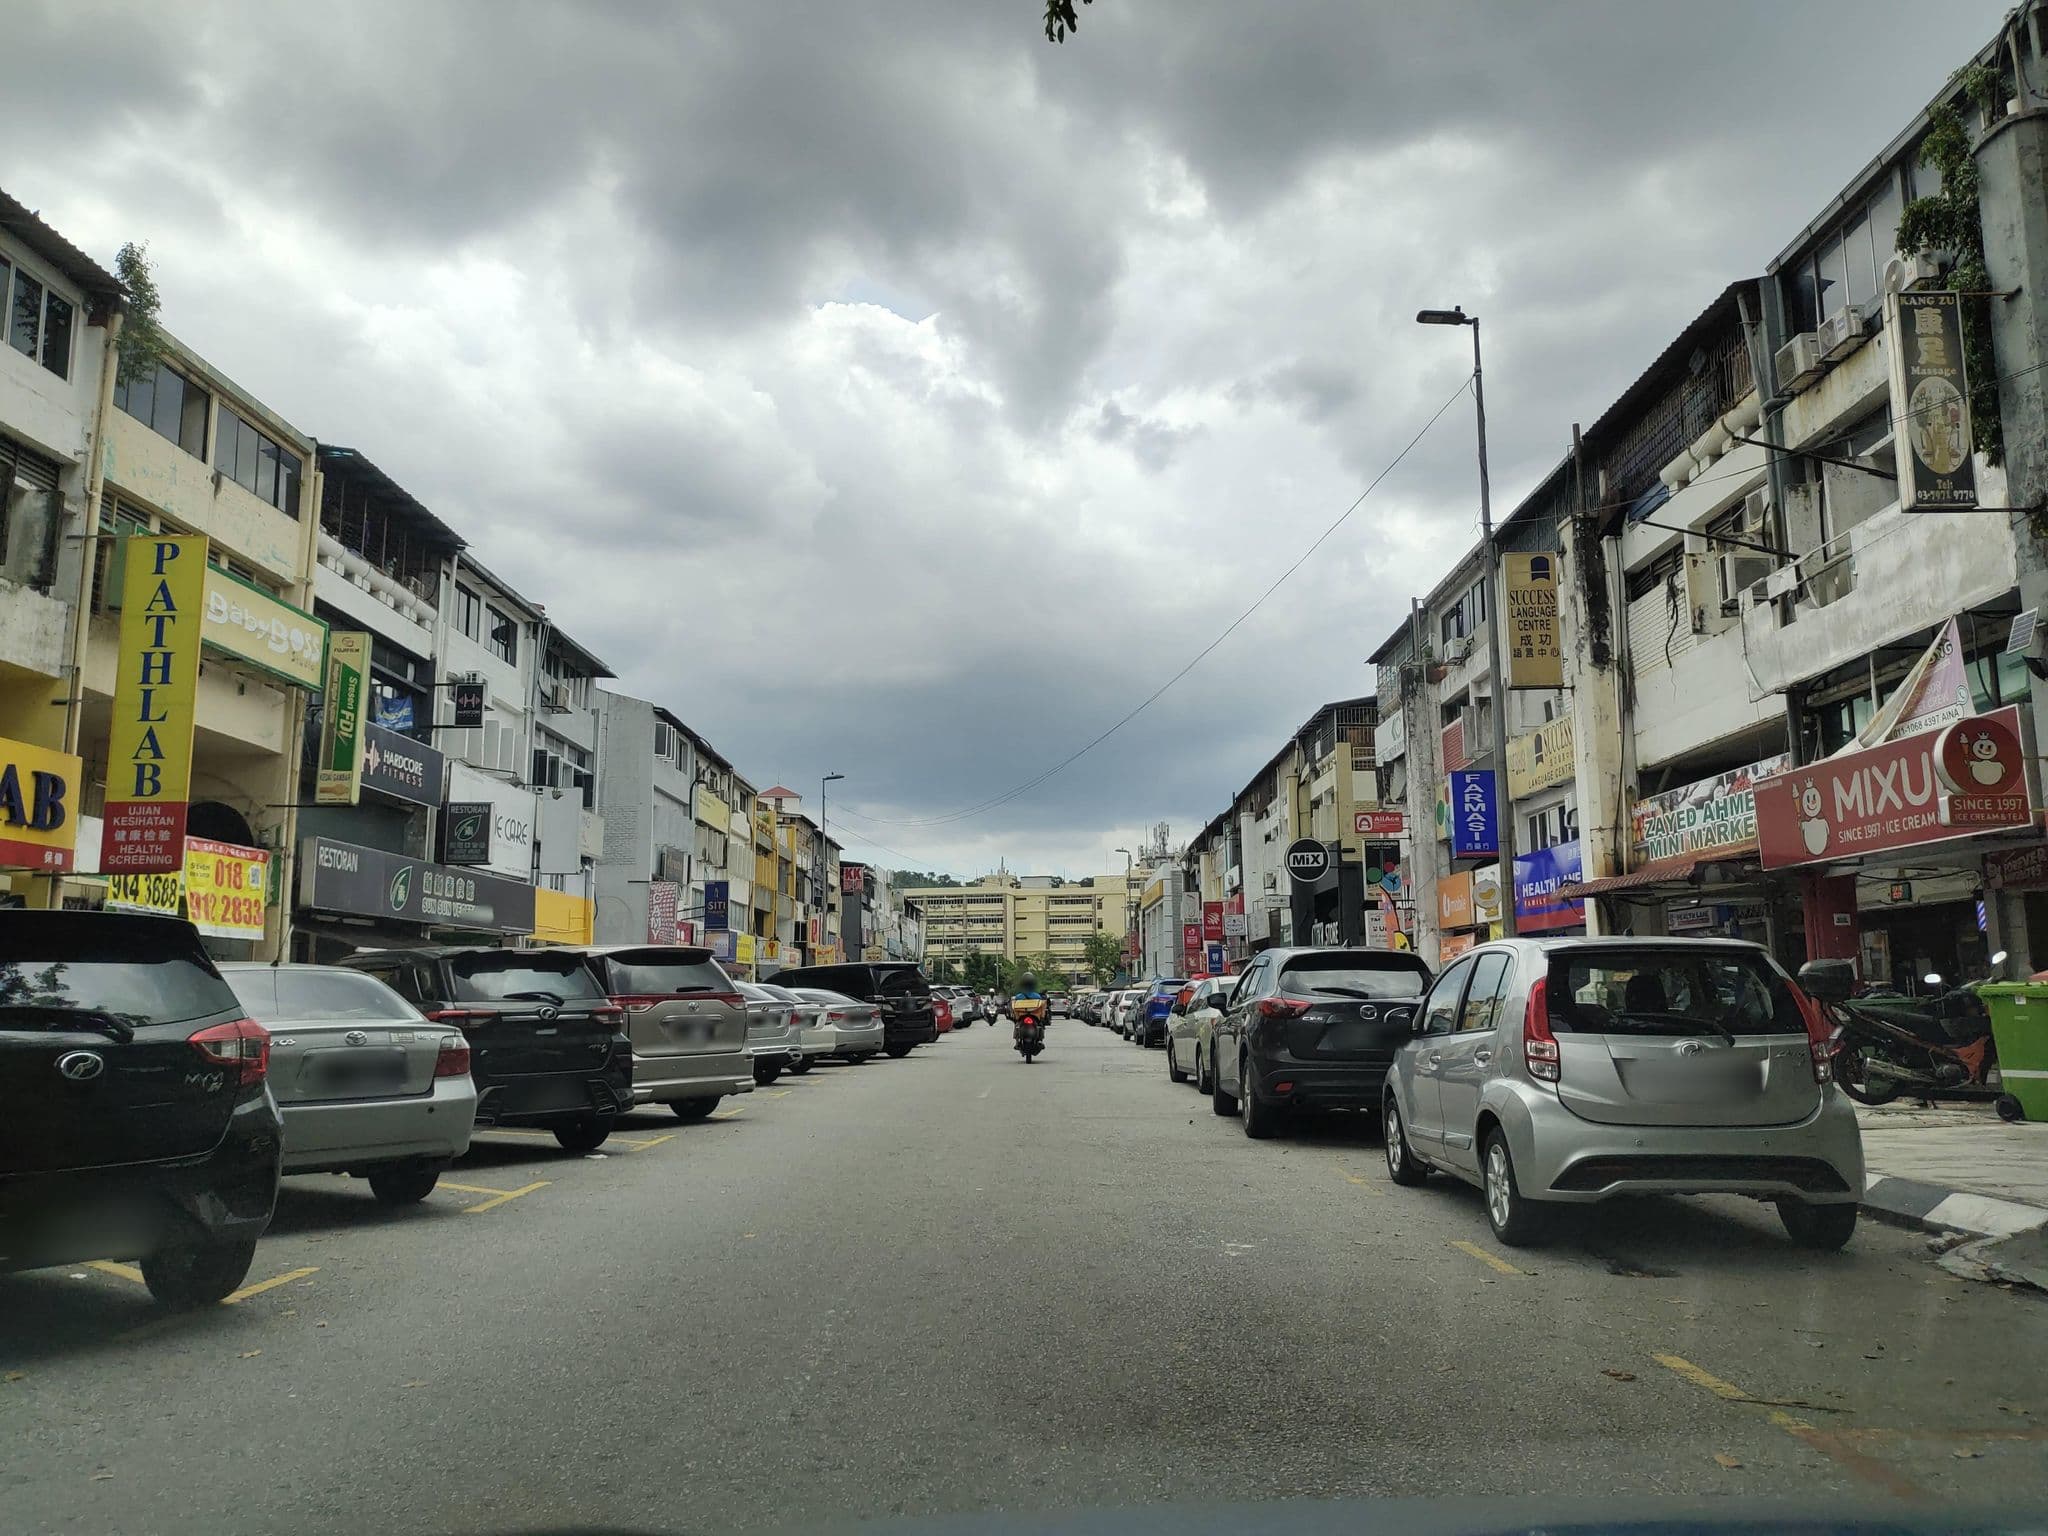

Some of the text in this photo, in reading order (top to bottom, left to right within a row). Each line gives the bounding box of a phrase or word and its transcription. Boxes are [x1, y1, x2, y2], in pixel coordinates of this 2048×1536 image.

[1938, 296, 1955, 305] ZU
[1911, 366, 1957, 377] Massage
[1509, 589, 1556, 605] SUCCESS
[1511, 606, 1557, 618] LANGUAGE
[1518, 619, 1551, 631] CENTRE
[1520, 633, 1552, 646] 成功
[132, 542, 180, 798] PATHLAB
[383, 750, 424, 776] HARDCORE
[382, 766, 423, 788] FITNESS
[128, 806, 160, 815] UJIAN
[450, 805, 489, 814] RESTORAN
[1464, 773, 1486, 841] FARMASI
[1954, 799, 2022, 810] SINCE 1997
[113, 816, 174, 826] KESIHATAN
[2008, 812, 2024, 820] TEA
[1644, 807, 1697, 840] ZAYED
[1839, 811, 1937, 844] SINCE 1997 ICE CREAM
[120, 845, 163, 854] HEALTH
[1649, 832, 1686, 860] MINI
[108, 855, 173, 864] SCREENING
[319, 846, 359, 872] RESTORAN
[214, 859, 243, 890] 018
[145, 875, 178, 908] 3688
[1522, 878, 1556, 899] HEALTH
[708, 901, 726, 910] SITI
[1524, 898, 1547, 907] FAMILY
[221, 895, 263, 926] 2833
